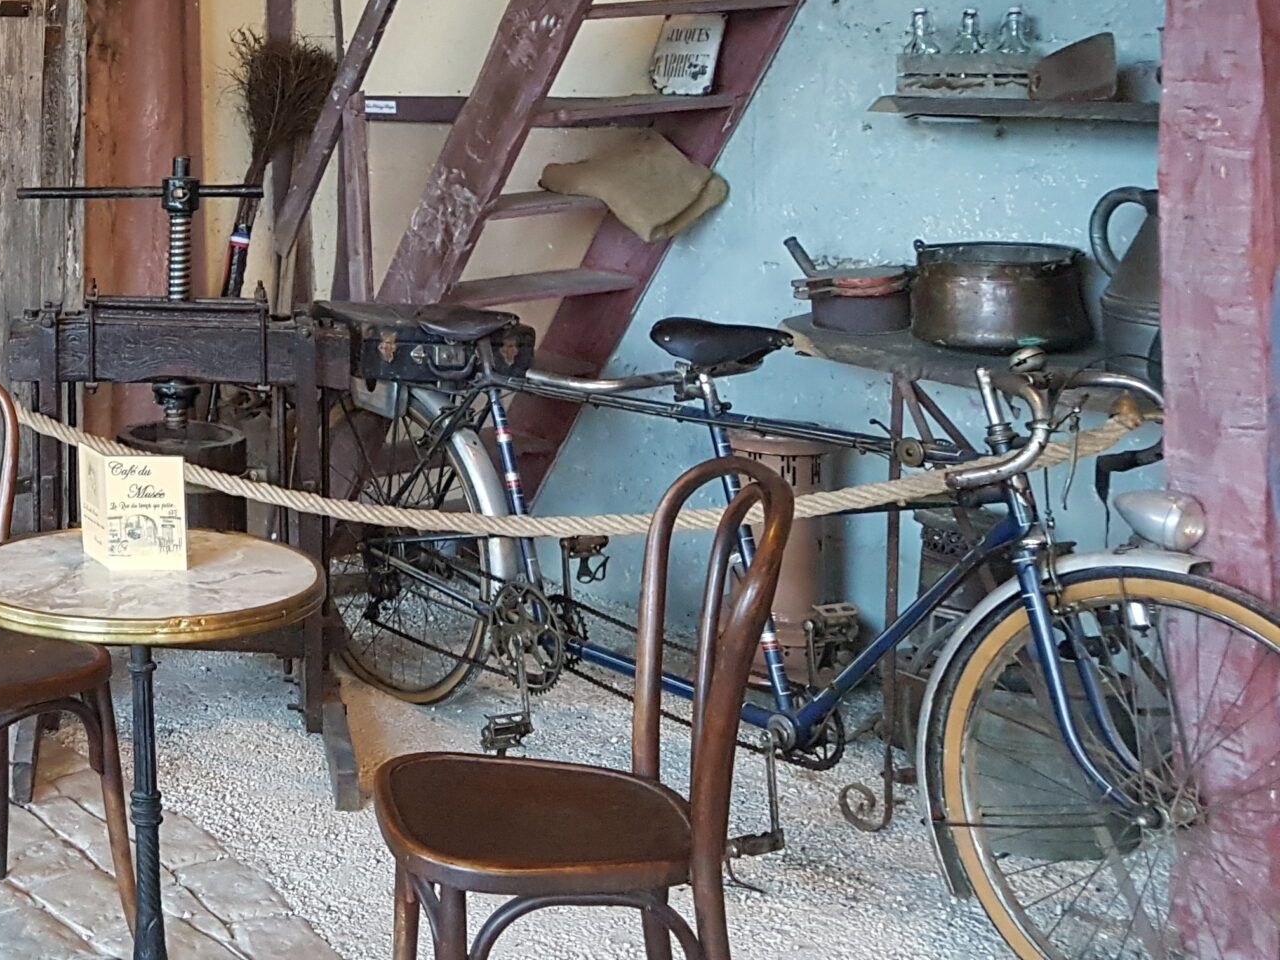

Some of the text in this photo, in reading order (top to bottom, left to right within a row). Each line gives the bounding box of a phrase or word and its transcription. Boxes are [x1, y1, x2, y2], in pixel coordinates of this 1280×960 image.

[108, 461, 151, 480] Café du
[127, 484, 166, 499] Musée
